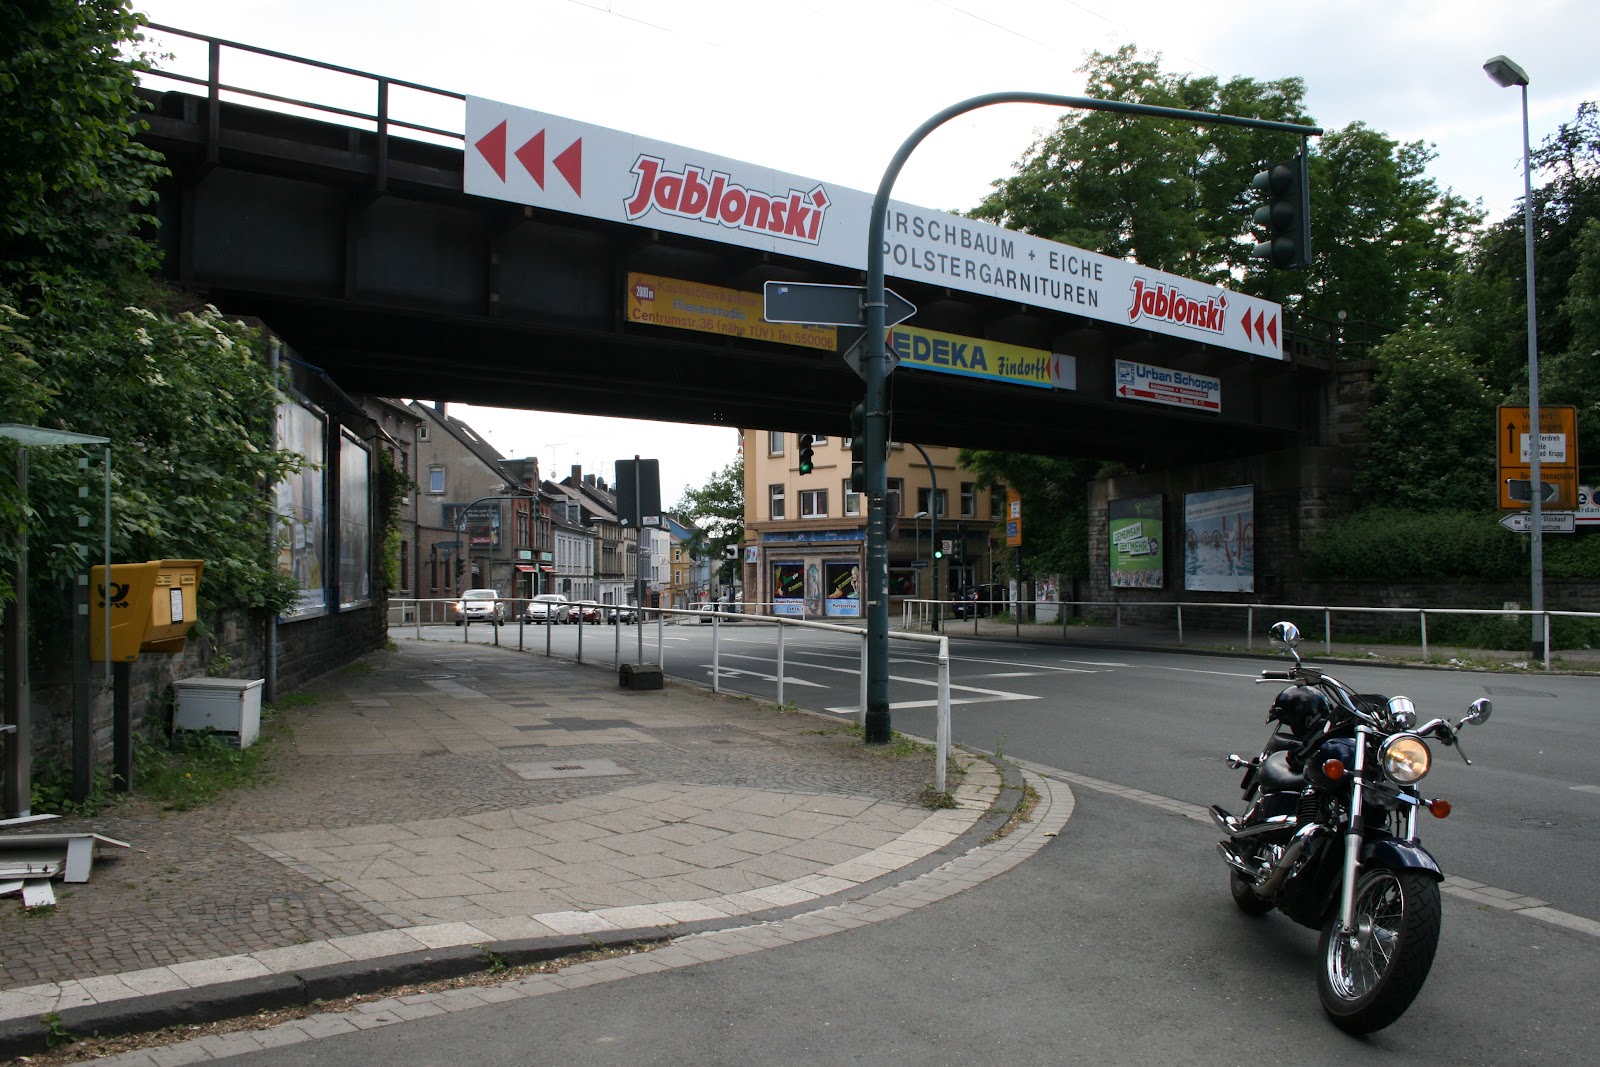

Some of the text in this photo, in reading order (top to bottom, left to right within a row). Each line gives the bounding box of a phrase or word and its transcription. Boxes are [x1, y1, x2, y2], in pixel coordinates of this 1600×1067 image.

[625, 155, 829, 244] Jablonski
[886, 210, 1014, 260] IRSCHBAUM
[1049, 251, 1103, 282] EICHE
[1128, 277, 1229, 334] Jablonski
[893, 332, 987, 371] EDEKA
[1136, 365, 1172, 383] Urban
[1173, 372, 1219, 391] Schoppe
